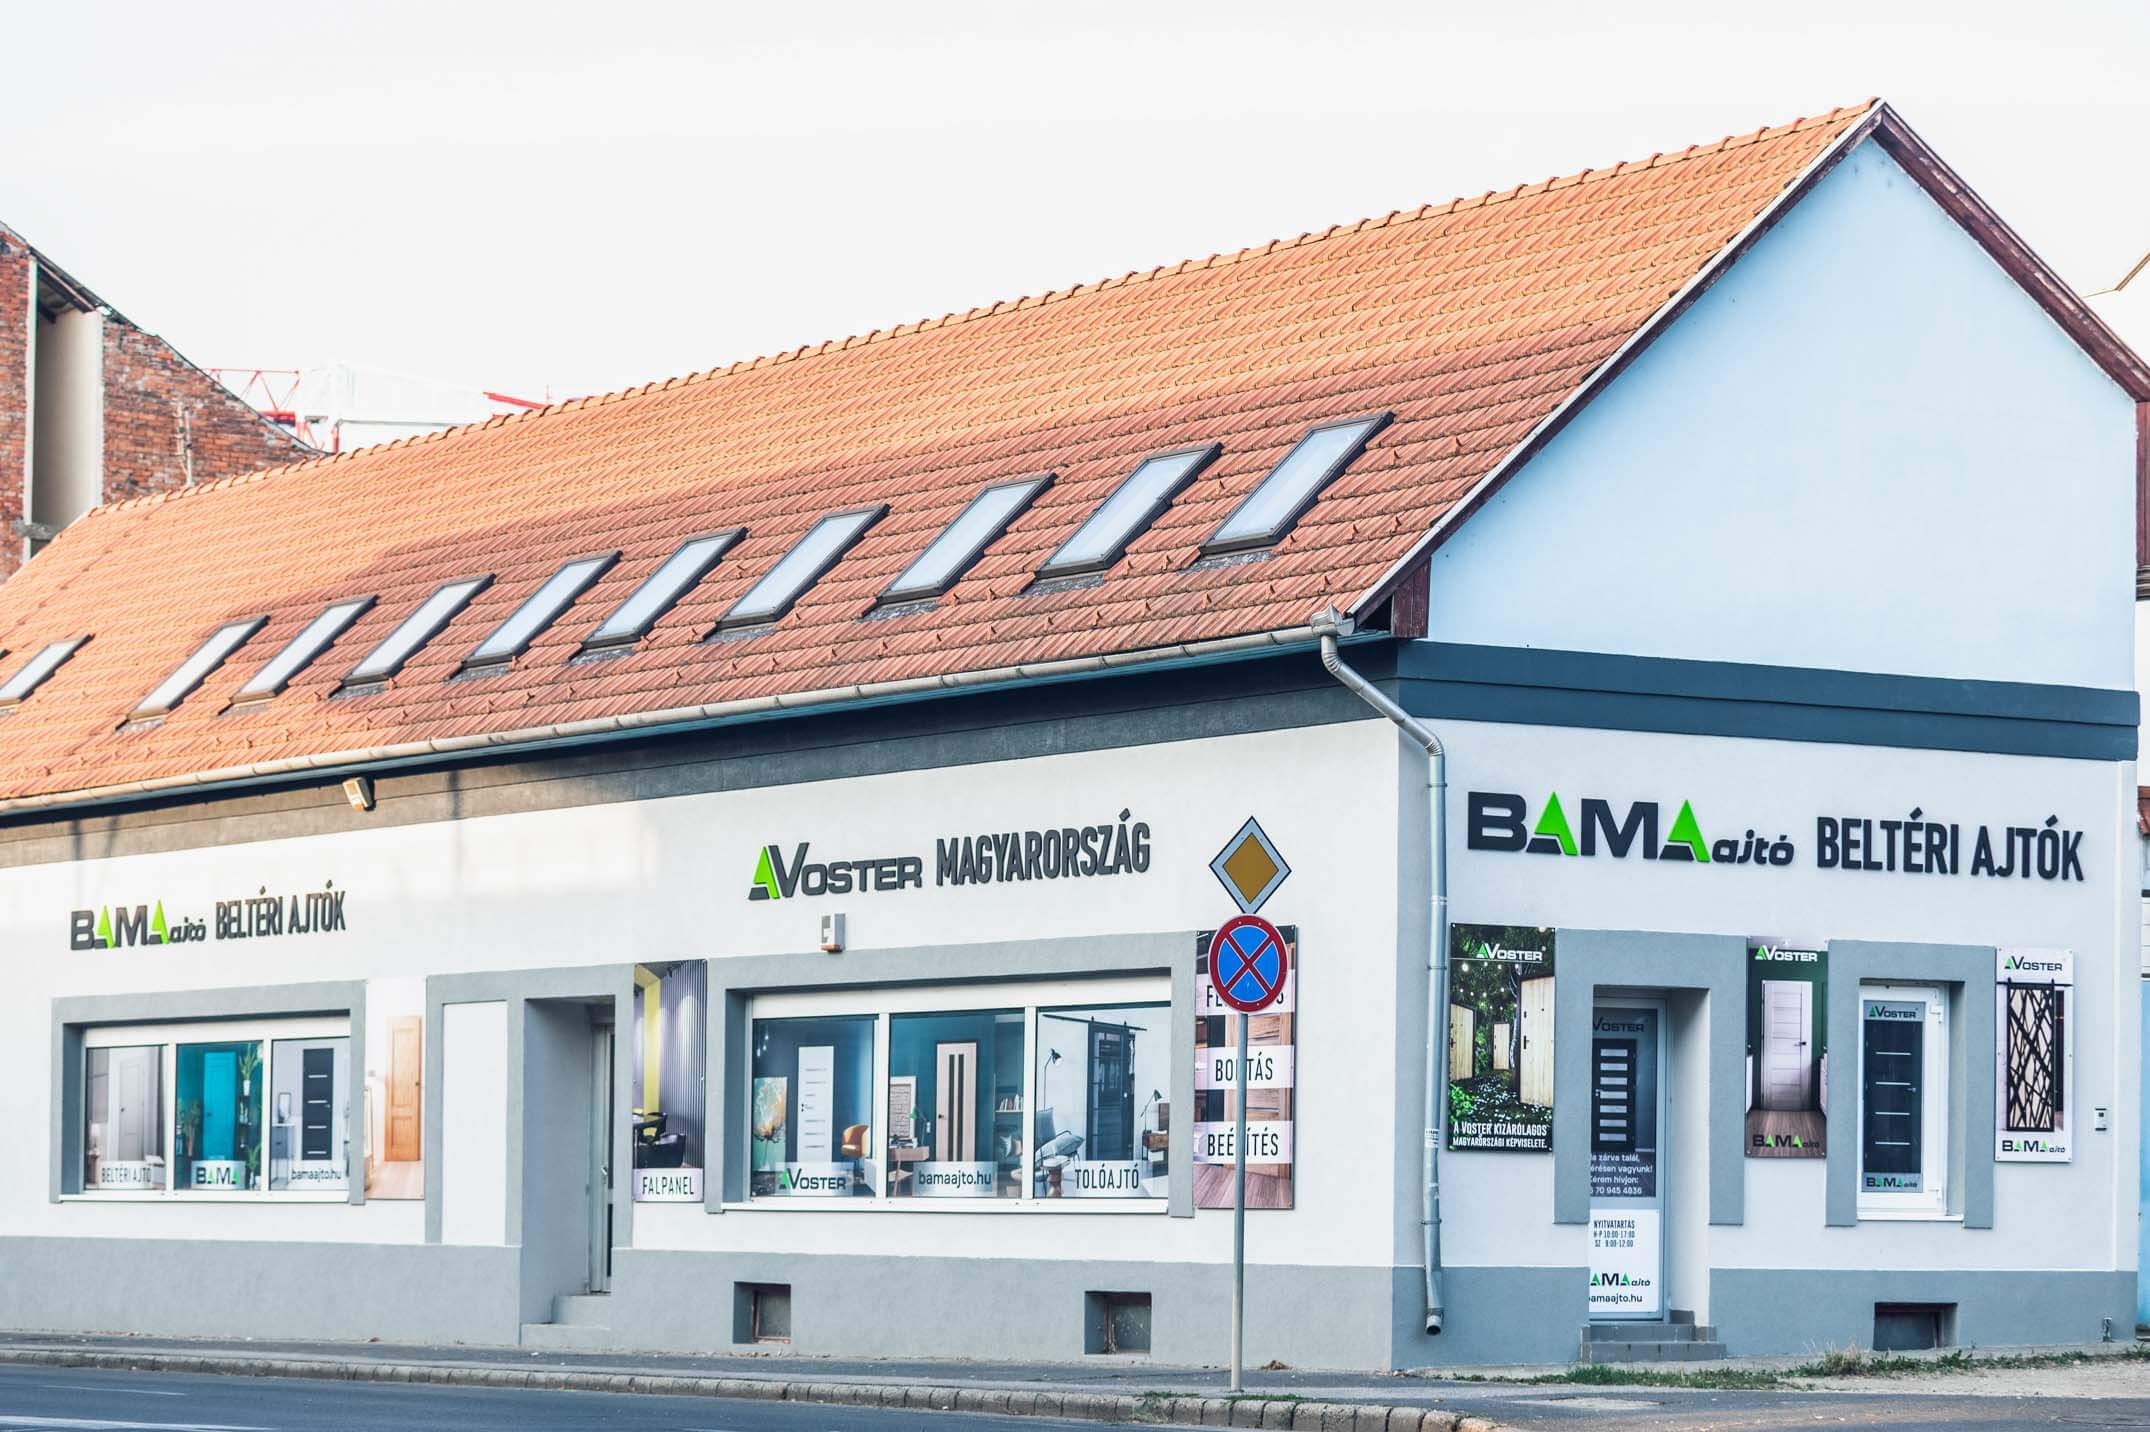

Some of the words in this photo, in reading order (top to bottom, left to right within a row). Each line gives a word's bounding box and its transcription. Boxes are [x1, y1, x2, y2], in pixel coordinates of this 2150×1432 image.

[1468, 791, 1710, 863] BAMA
[1817, 807, 1959, 875] BELTÉRI
[1971, 814, 2084, 881] AJTÓK
[936, 808, 1151, 886] MAGYARORSZÁG
[71, 899, 169, 951] BAMA
[216, 886, 283, 940] BELTÉRI
[288, 879, 346, 934] AJTÓK
[1593, 1017, 1645, 1032] VOSTER
[1215, 1051, 1273, 1082] BOTÁS
[1453, 1122, 1459, 1134] A
[1461, 1122, 1492, 1134] VOSTER
[1207, 1127, 1279, 1157] BEÉÍTÉS
[196, 1166, 241, 1185] BAMA
[1074, 1163, 1139, 1189] TOLÓAJTÓ
[1590, 1164, 1617, 1172] érésen
[642, 1176, 695, 1195] FALPANEL
[918, 1169, 992, 1188] bamaajto.hu
[1590, 1273, 1630, 1286] AMA
[1589, 1293, 1643, 1304] amaajto.hu
